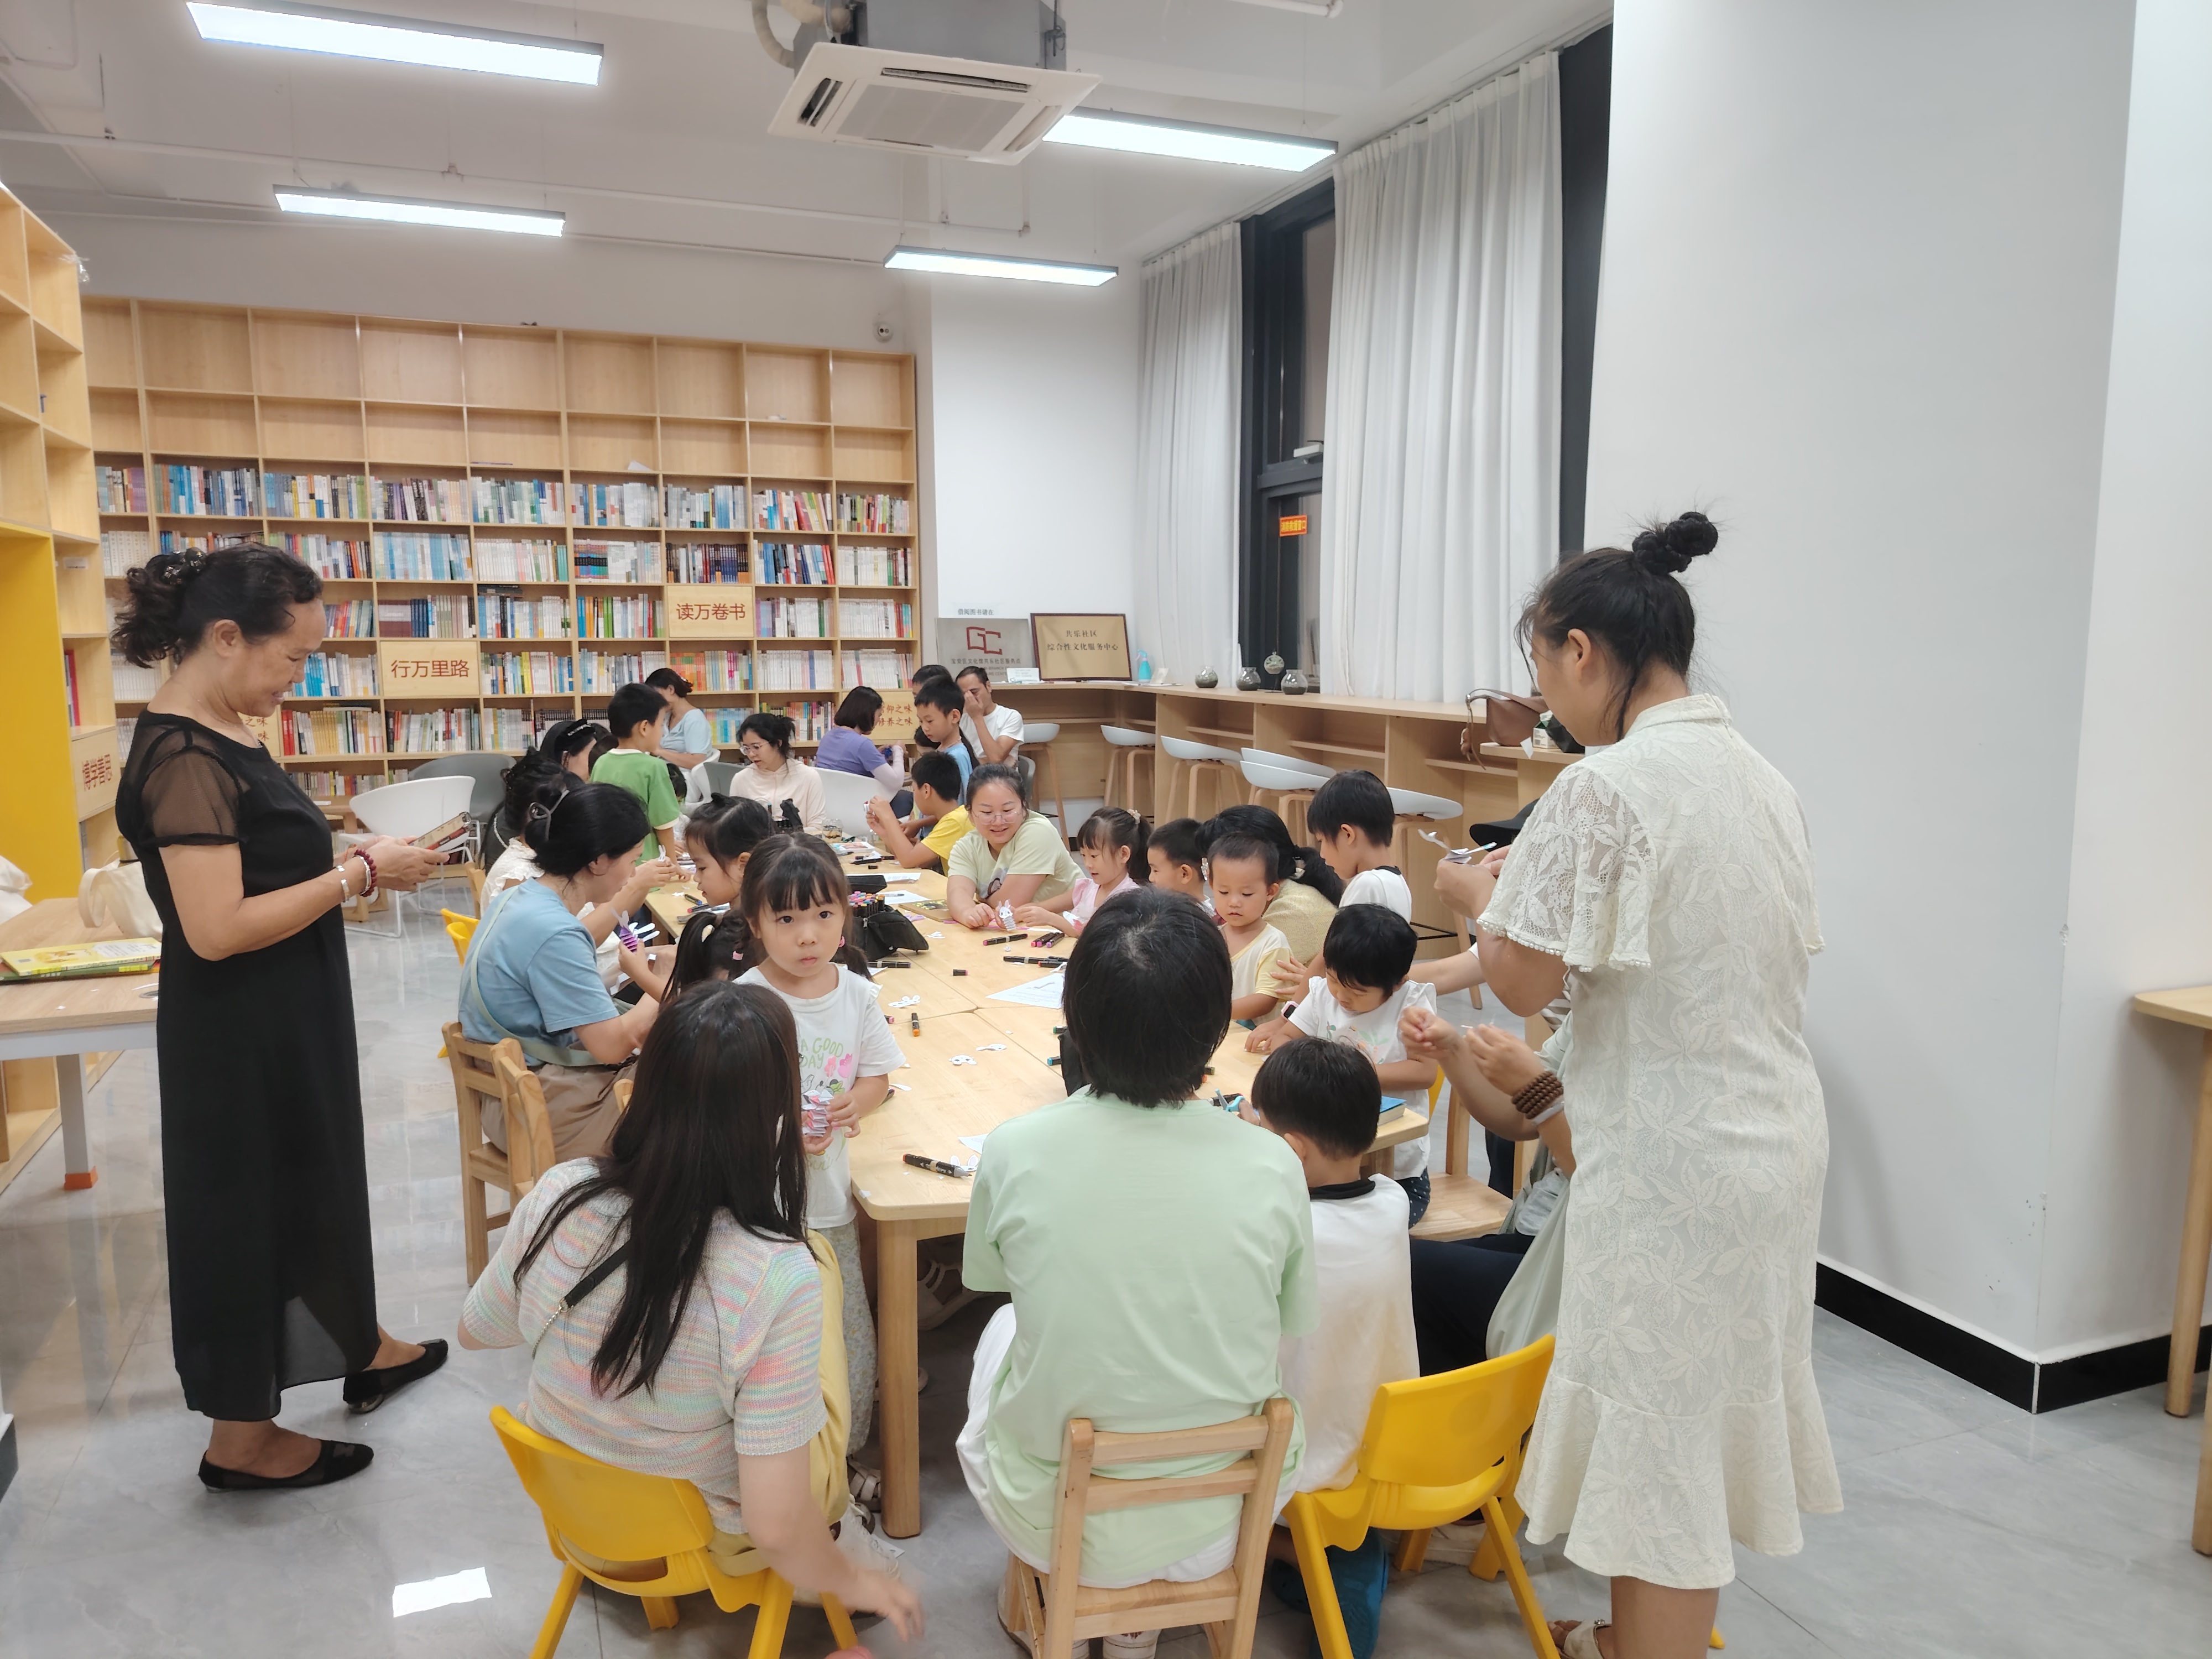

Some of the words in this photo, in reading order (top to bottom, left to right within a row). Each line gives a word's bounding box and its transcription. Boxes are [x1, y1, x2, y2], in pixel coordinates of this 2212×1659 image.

[676, 603, 746, 620] 读万卷书
[391, 660, 469, 678] 行万里路
[881, 703, 912, 714] 仰之味
[81, 754, 113, 792] 博学善思
[801, 1039, 808, 1052] A
[812, 1037, 843, 1058] GOOD
